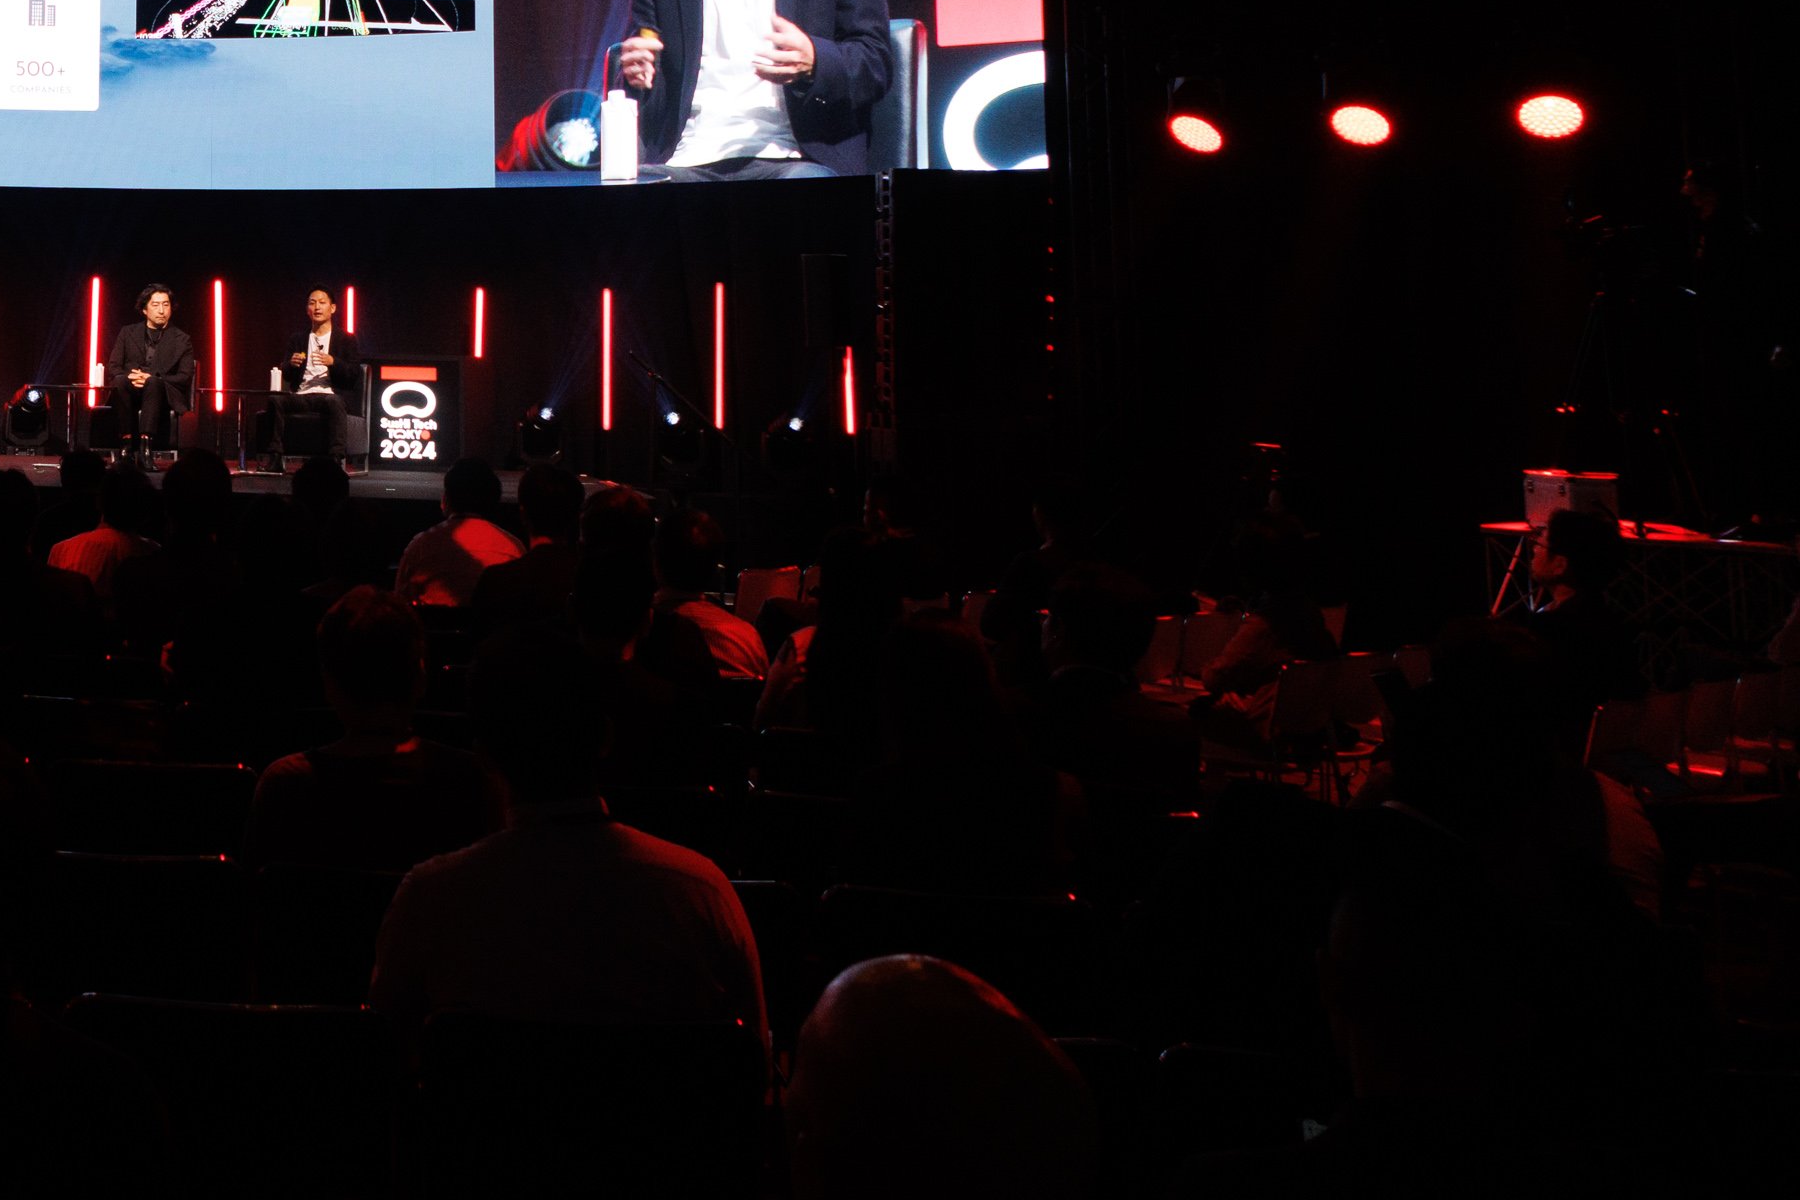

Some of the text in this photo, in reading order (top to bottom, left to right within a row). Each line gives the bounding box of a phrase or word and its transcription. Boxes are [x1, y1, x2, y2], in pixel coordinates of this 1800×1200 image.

[15, 60, 66, 77] 500+
[9, 84, 73, 95] COMPANIES
[380, 439, 437, 460] 2024
